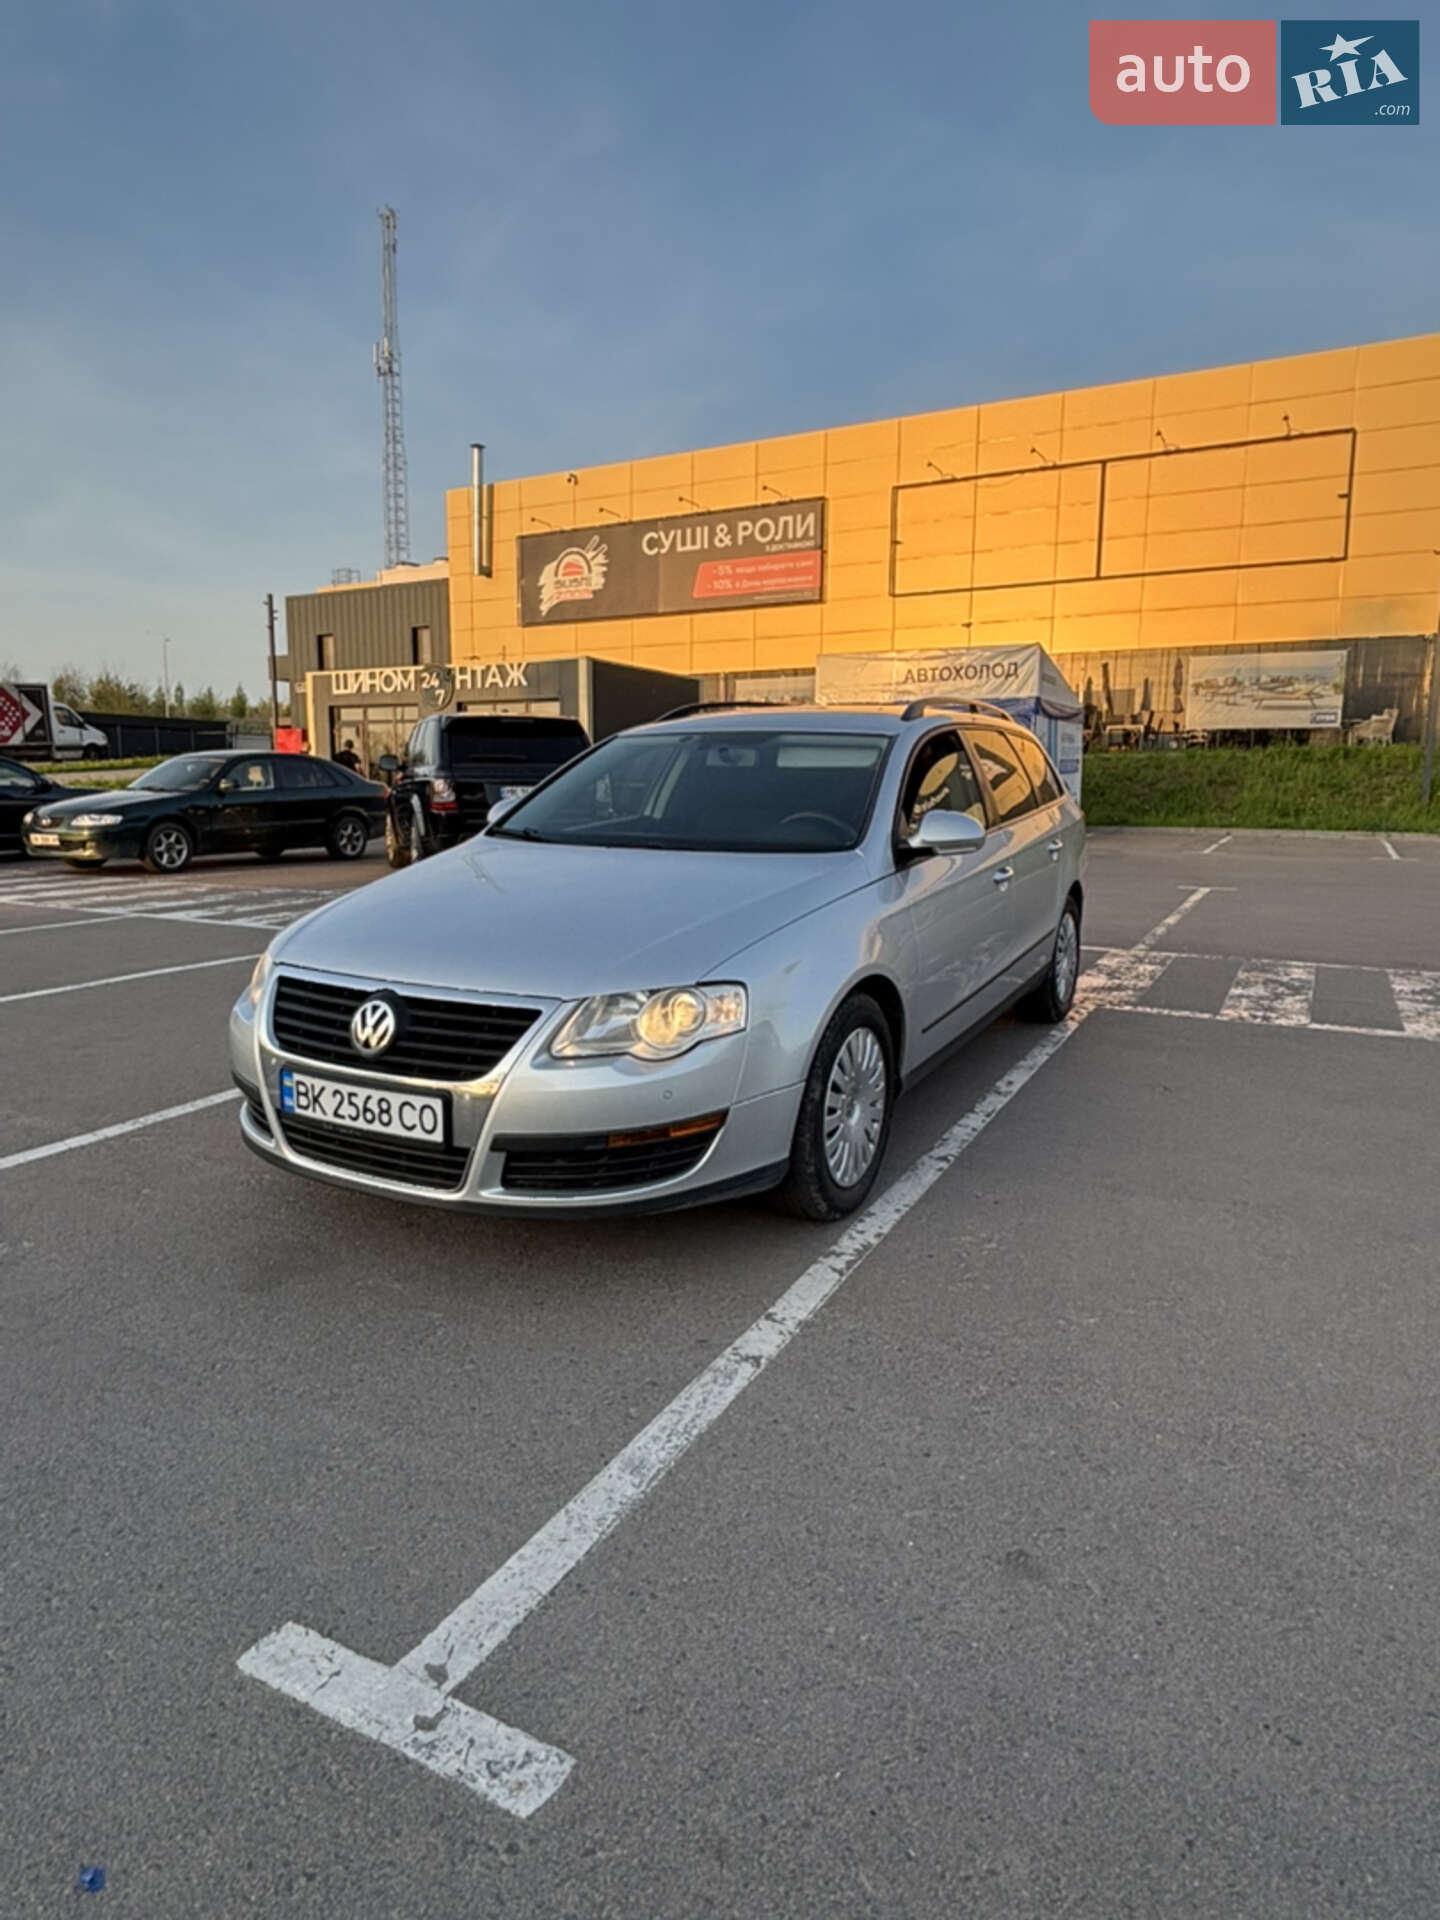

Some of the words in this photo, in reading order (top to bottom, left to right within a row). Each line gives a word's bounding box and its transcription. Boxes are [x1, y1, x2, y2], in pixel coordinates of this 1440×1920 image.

[641, 526, 708, 555] СУШІ
[714, 523, 732, 549] &
[737, 512, 815, 546] РОЛИ
[331, 669, 415, 695] ШИНОМ
[455, 662, 528, 690] НТАЖ
[902, 662, 1019, 684] АВТОХОЛОД
[295, 1080, 328, 1116] BK
[332, 1089, 393, 1127] 2568
[398, 1101, 438, 1135] CO
